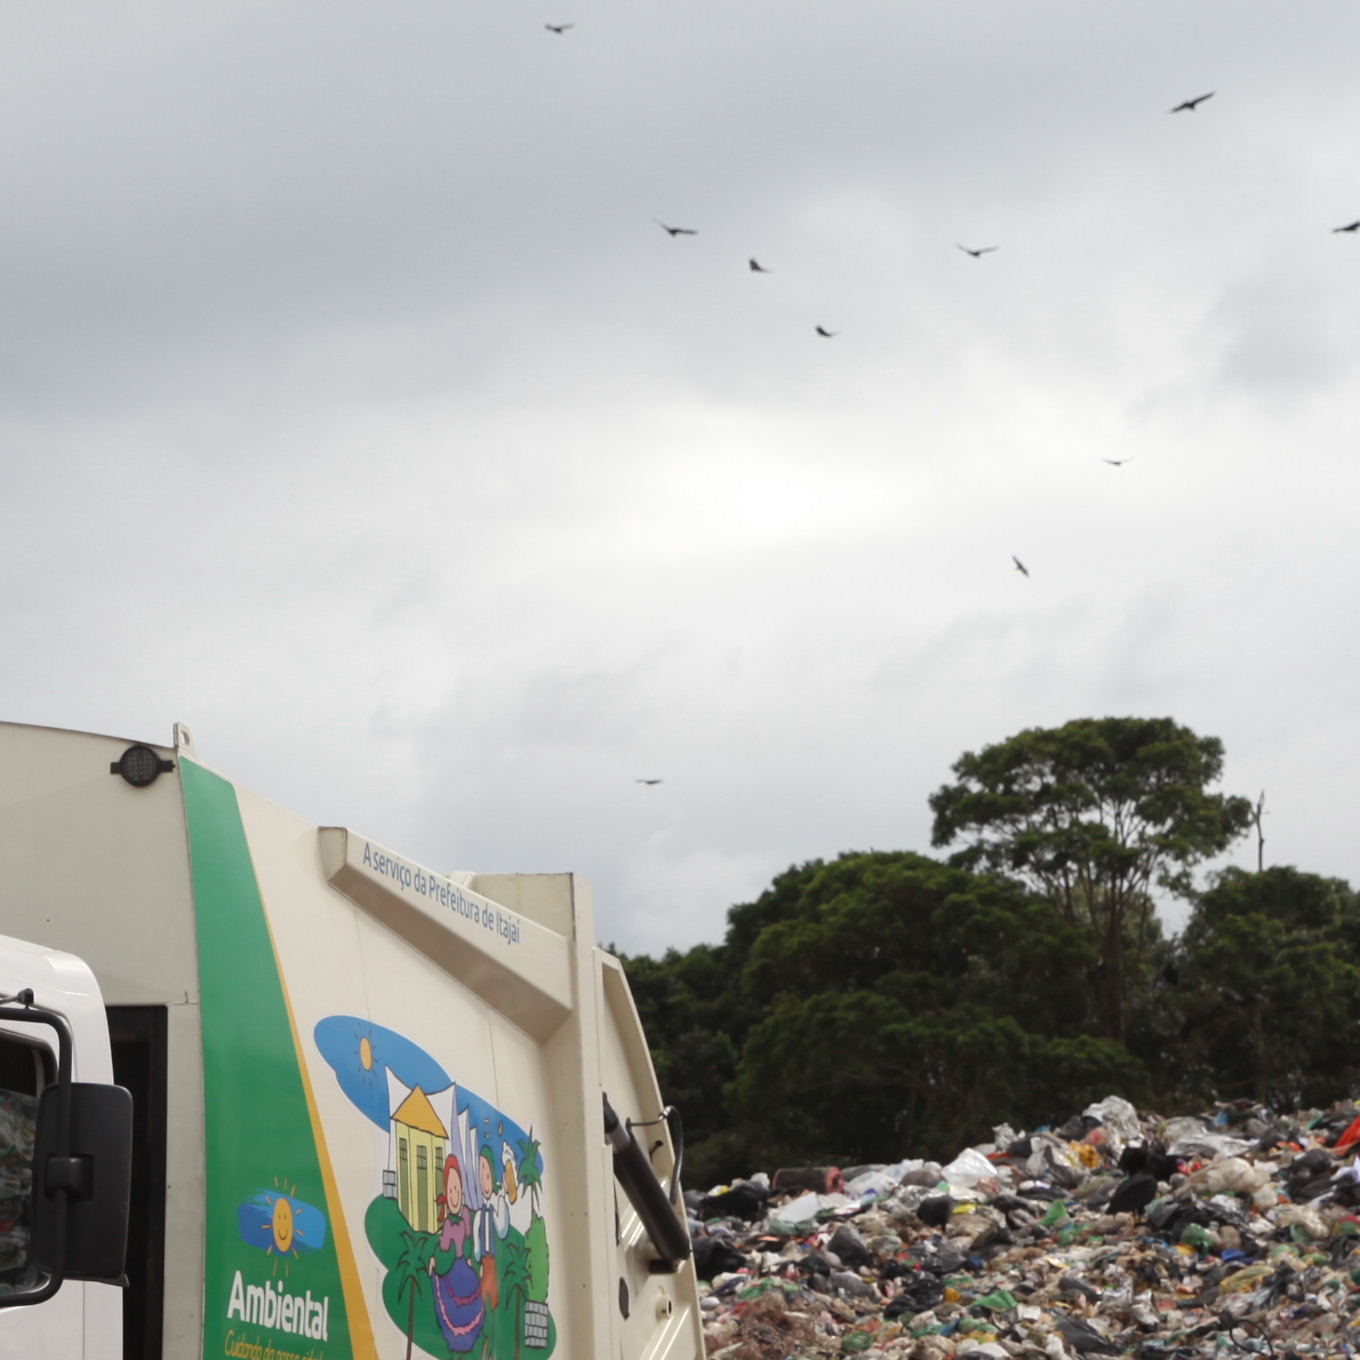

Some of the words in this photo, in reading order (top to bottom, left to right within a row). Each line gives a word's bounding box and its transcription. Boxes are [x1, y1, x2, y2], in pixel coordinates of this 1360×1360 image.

[362, 841, 372, 867] A
[373, 851, 412, 891] serviço
[413, 867, 427, 896] da
[428, 876, 480, 924] Prefeitura
[481, 902, 494, 931] de
[495, 911, 521, 945] Itajaí
[226, 1269, 329, 1342] Ambiental
